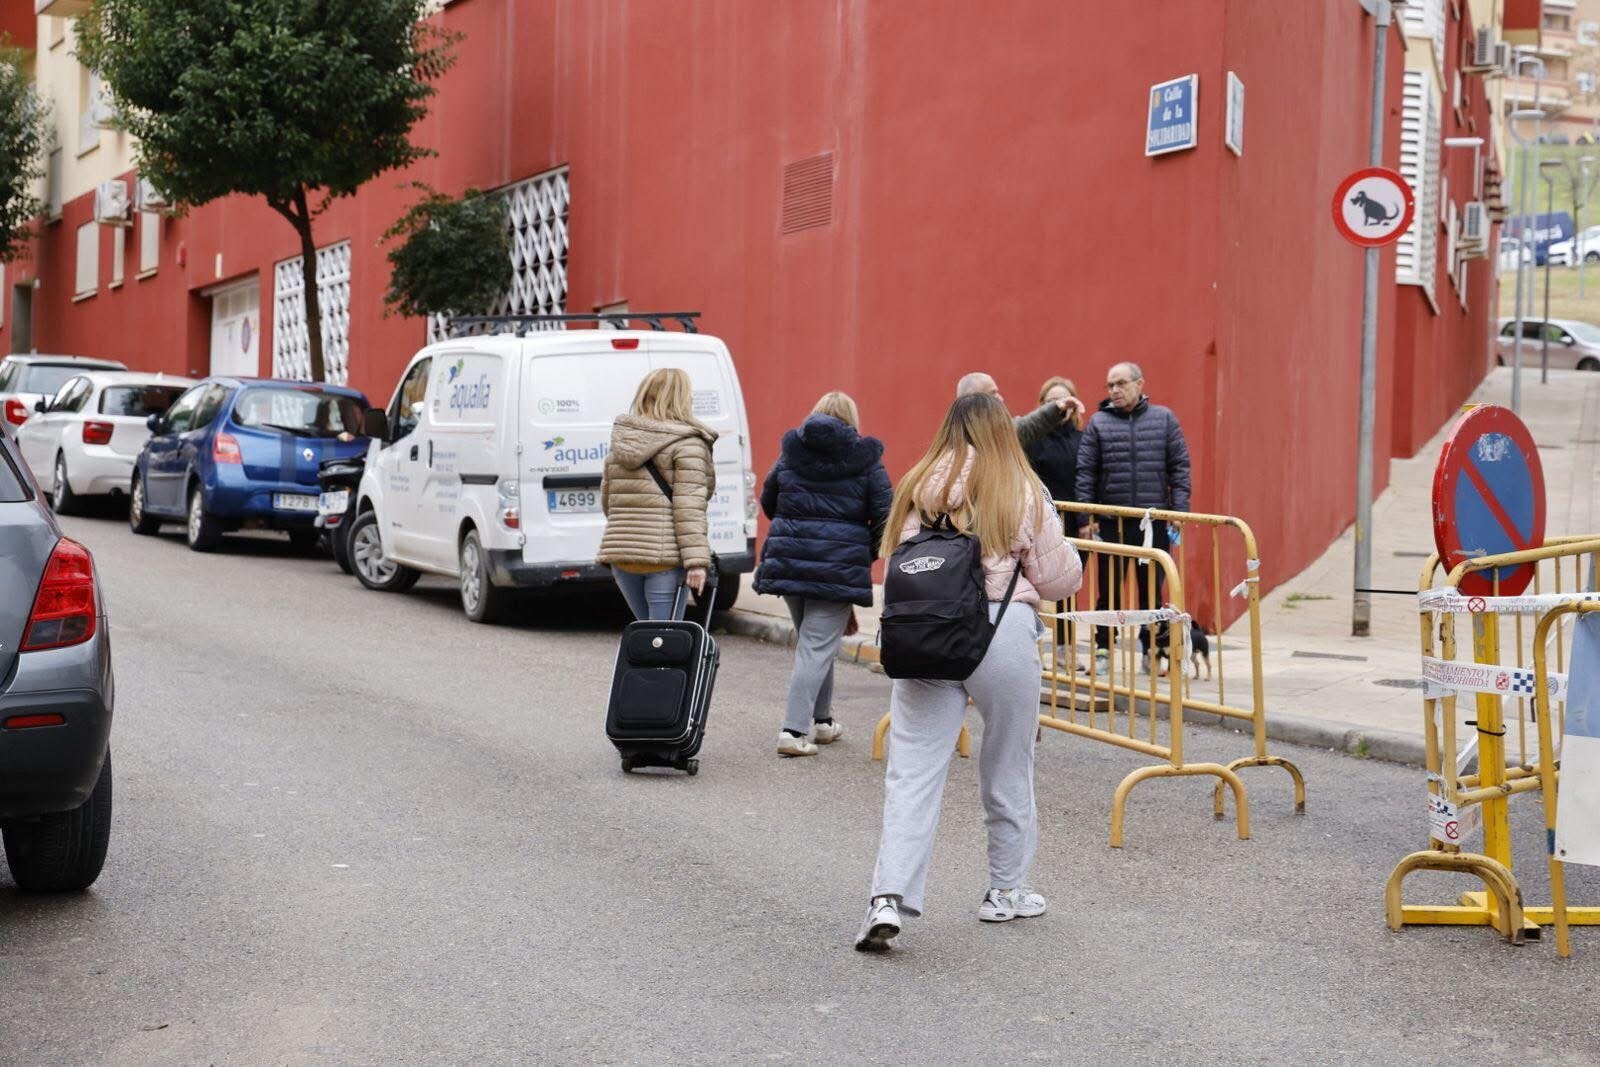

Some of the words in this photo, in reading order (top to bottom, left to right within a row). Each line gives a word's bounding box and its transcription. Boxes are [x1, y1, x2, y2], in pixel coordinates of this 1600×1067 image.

[1164, 86, 1183, 102] Calle
[1163, 107, 1172, 121] de
[1175, 104, 1183, 118] la
[450, 373, 491, 418] aqualia
[554, 442, 611, 465] aquali
[559, 492, 596, 506] 4699
